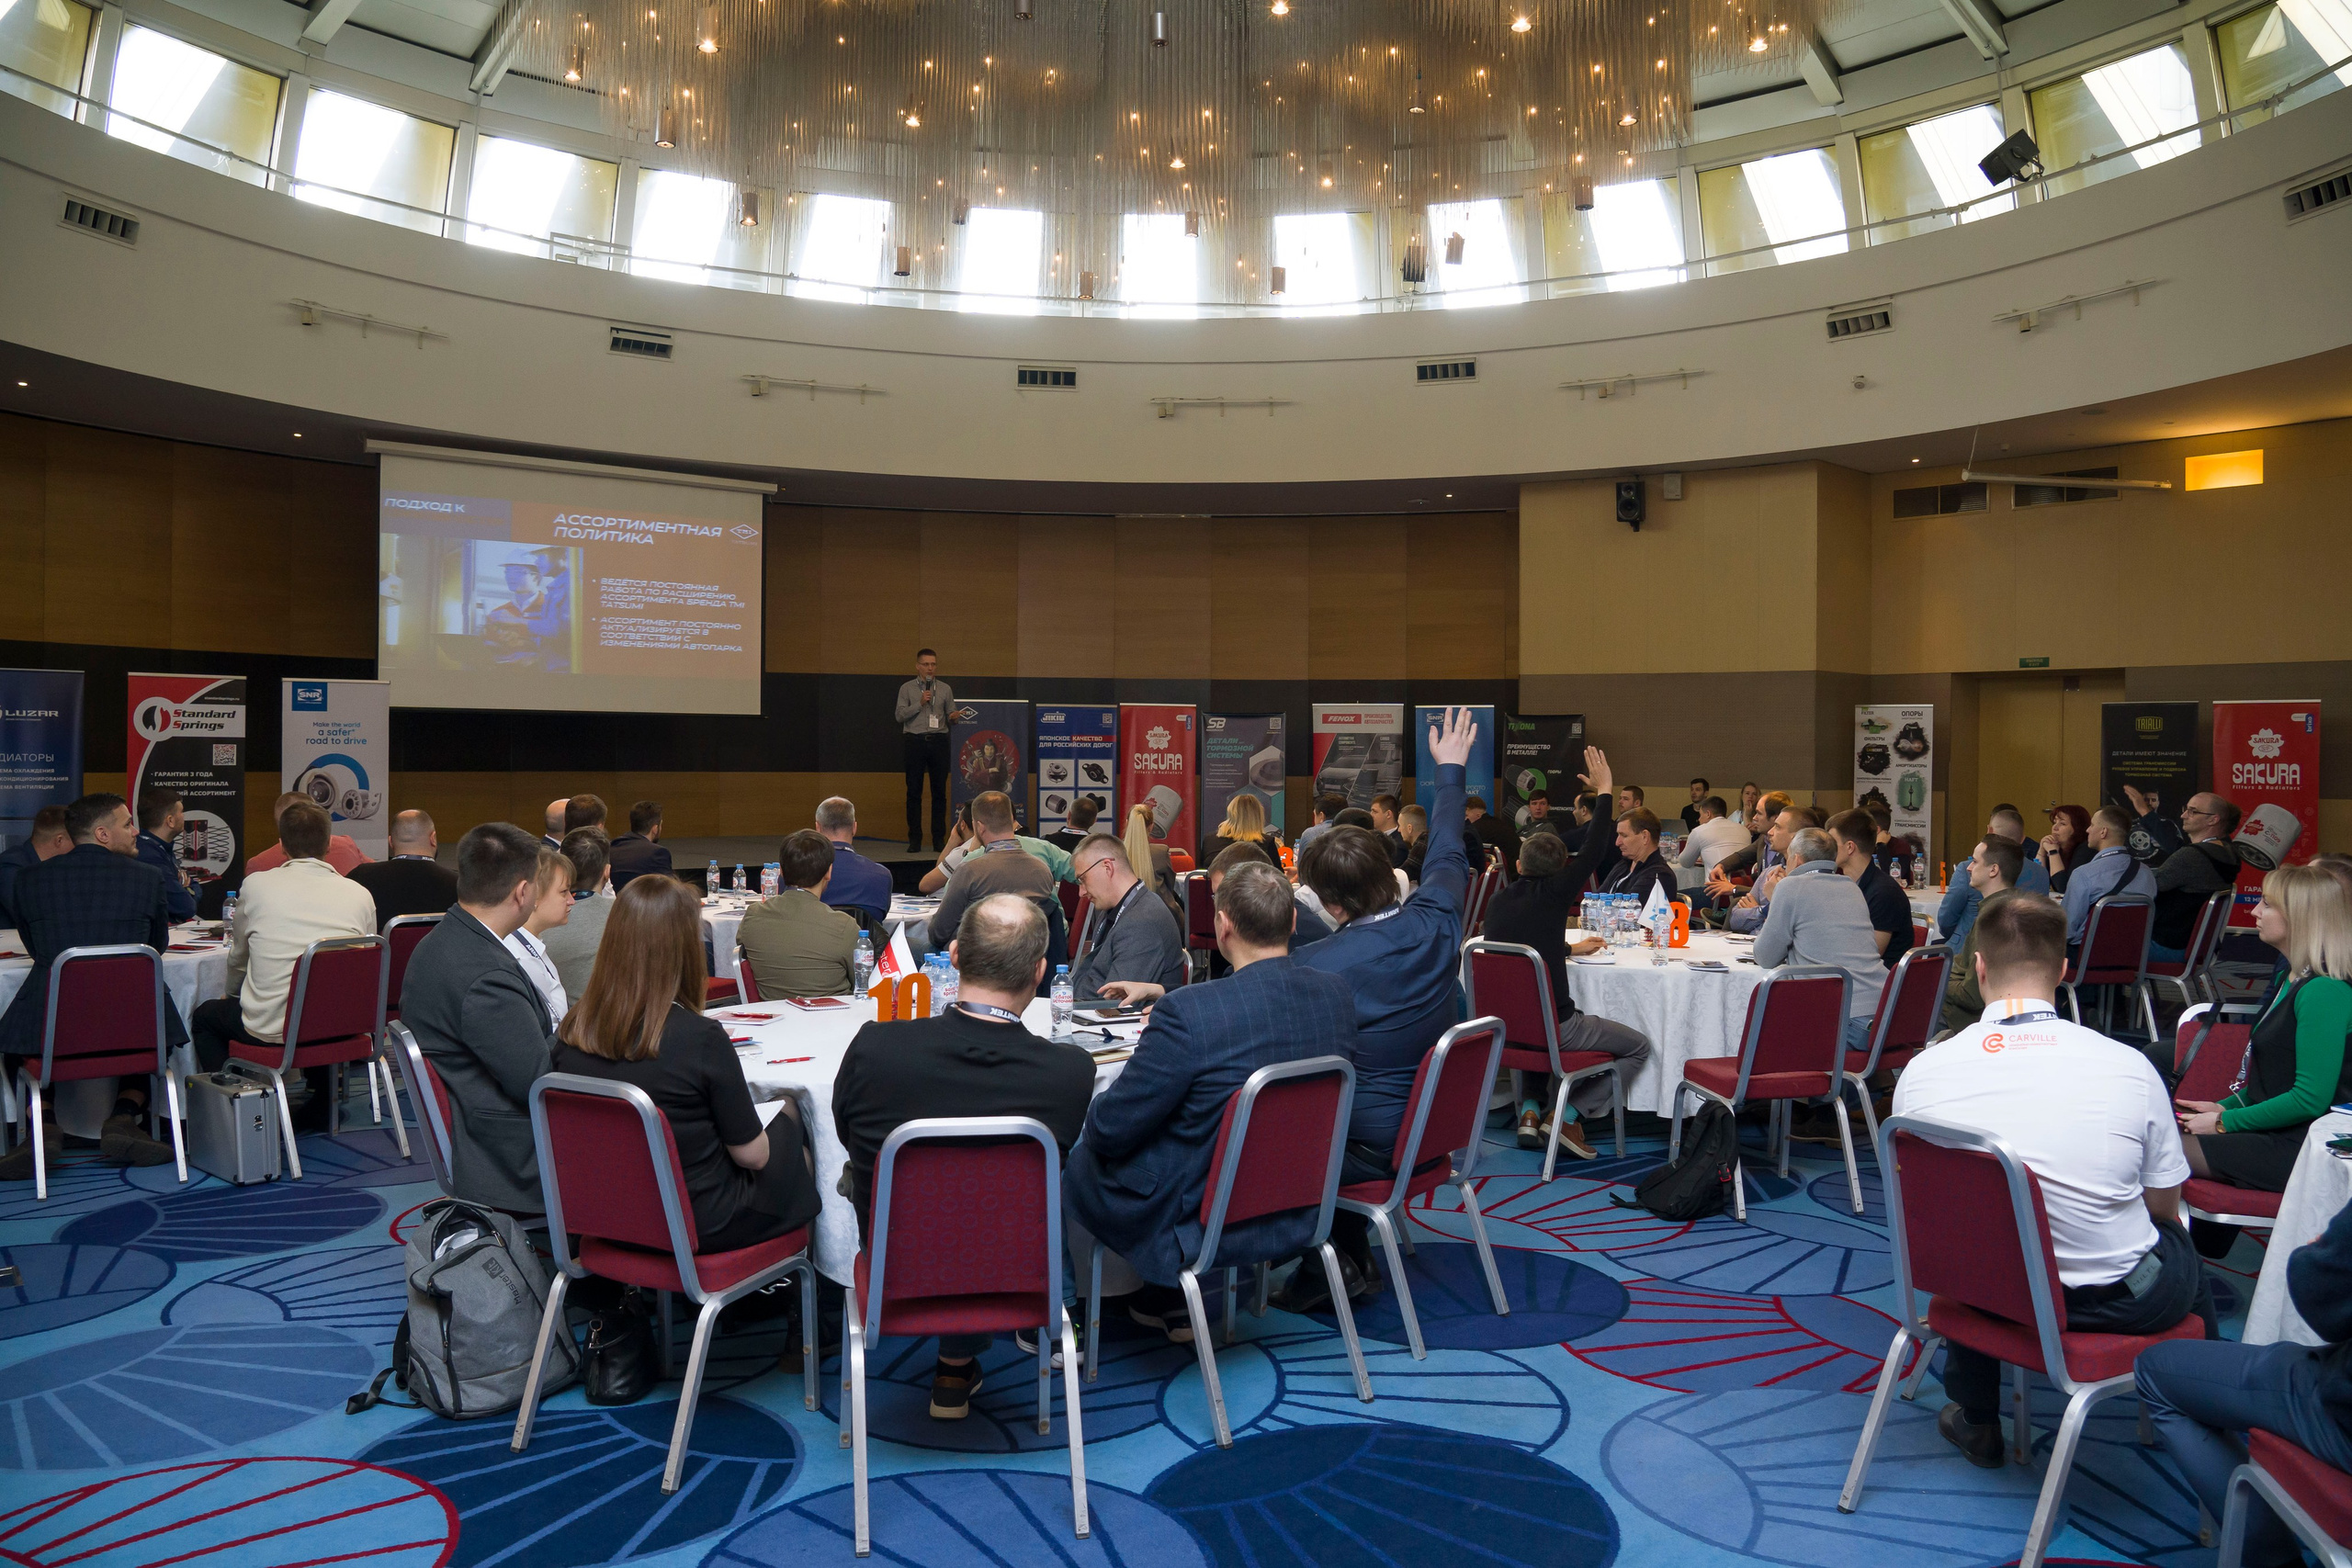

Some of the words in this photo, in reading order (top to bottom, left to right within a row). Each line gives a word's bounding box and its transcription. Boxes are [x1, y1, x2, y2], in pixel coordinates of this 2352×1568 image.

[384, 498, 452, 513] ПОДХОД
[454, 503, 466, 513] К
[553, 513, 723, 537] АССОРТИМЕНТНАЯ
[554, 526, 654, 545] ПОЛИТИКА
[600, 585, 642, 594] РАБОТА
[662, 590, 737, 600] РАСШИРЕНИЮ
[649, 580, 719, 592] ПОСТОЯННАЯ
[600, 593, 684, 604] АССОРТИМЕНТА
[686, 597, 727, 607] БРЕНДА
[600, 601, 644, 610] TATSUMI
[600, 616, 678, 626] АССОРТИМЕНТ
[680, 620, 742, 630] ПОСТОЯННО
[600, 624, 700, 635] АКТУАЛИЗИРУЕТСЯ
[600, 632, 682, 642] СООТВЕТСТВИИ
[600, 639, 681, 649] ИЗМЕНЕНИЯМИ
[682, 643, 743, 652] АВТОПАРКА
[5, 709, 59, 717] LUZAR
[173, 708, 237, 718] Standard
[173, 720, 225, 731] Springs
[1206, 717, 1227, 728] SB
[2137, 717, 2162, 730] TRIALLI
[344, 737, 368, 745] drive
[1134, 753, 1182, 771] SAKURA
[2232, 762, 2301, 785] SAKURA
[1668, 901, 1690, 948] 8
[868, 972, 932, 1022] 10
[2008, 1033, 2057, 1043] CARVILLE
[499, 1273, 522, 1305] Master
